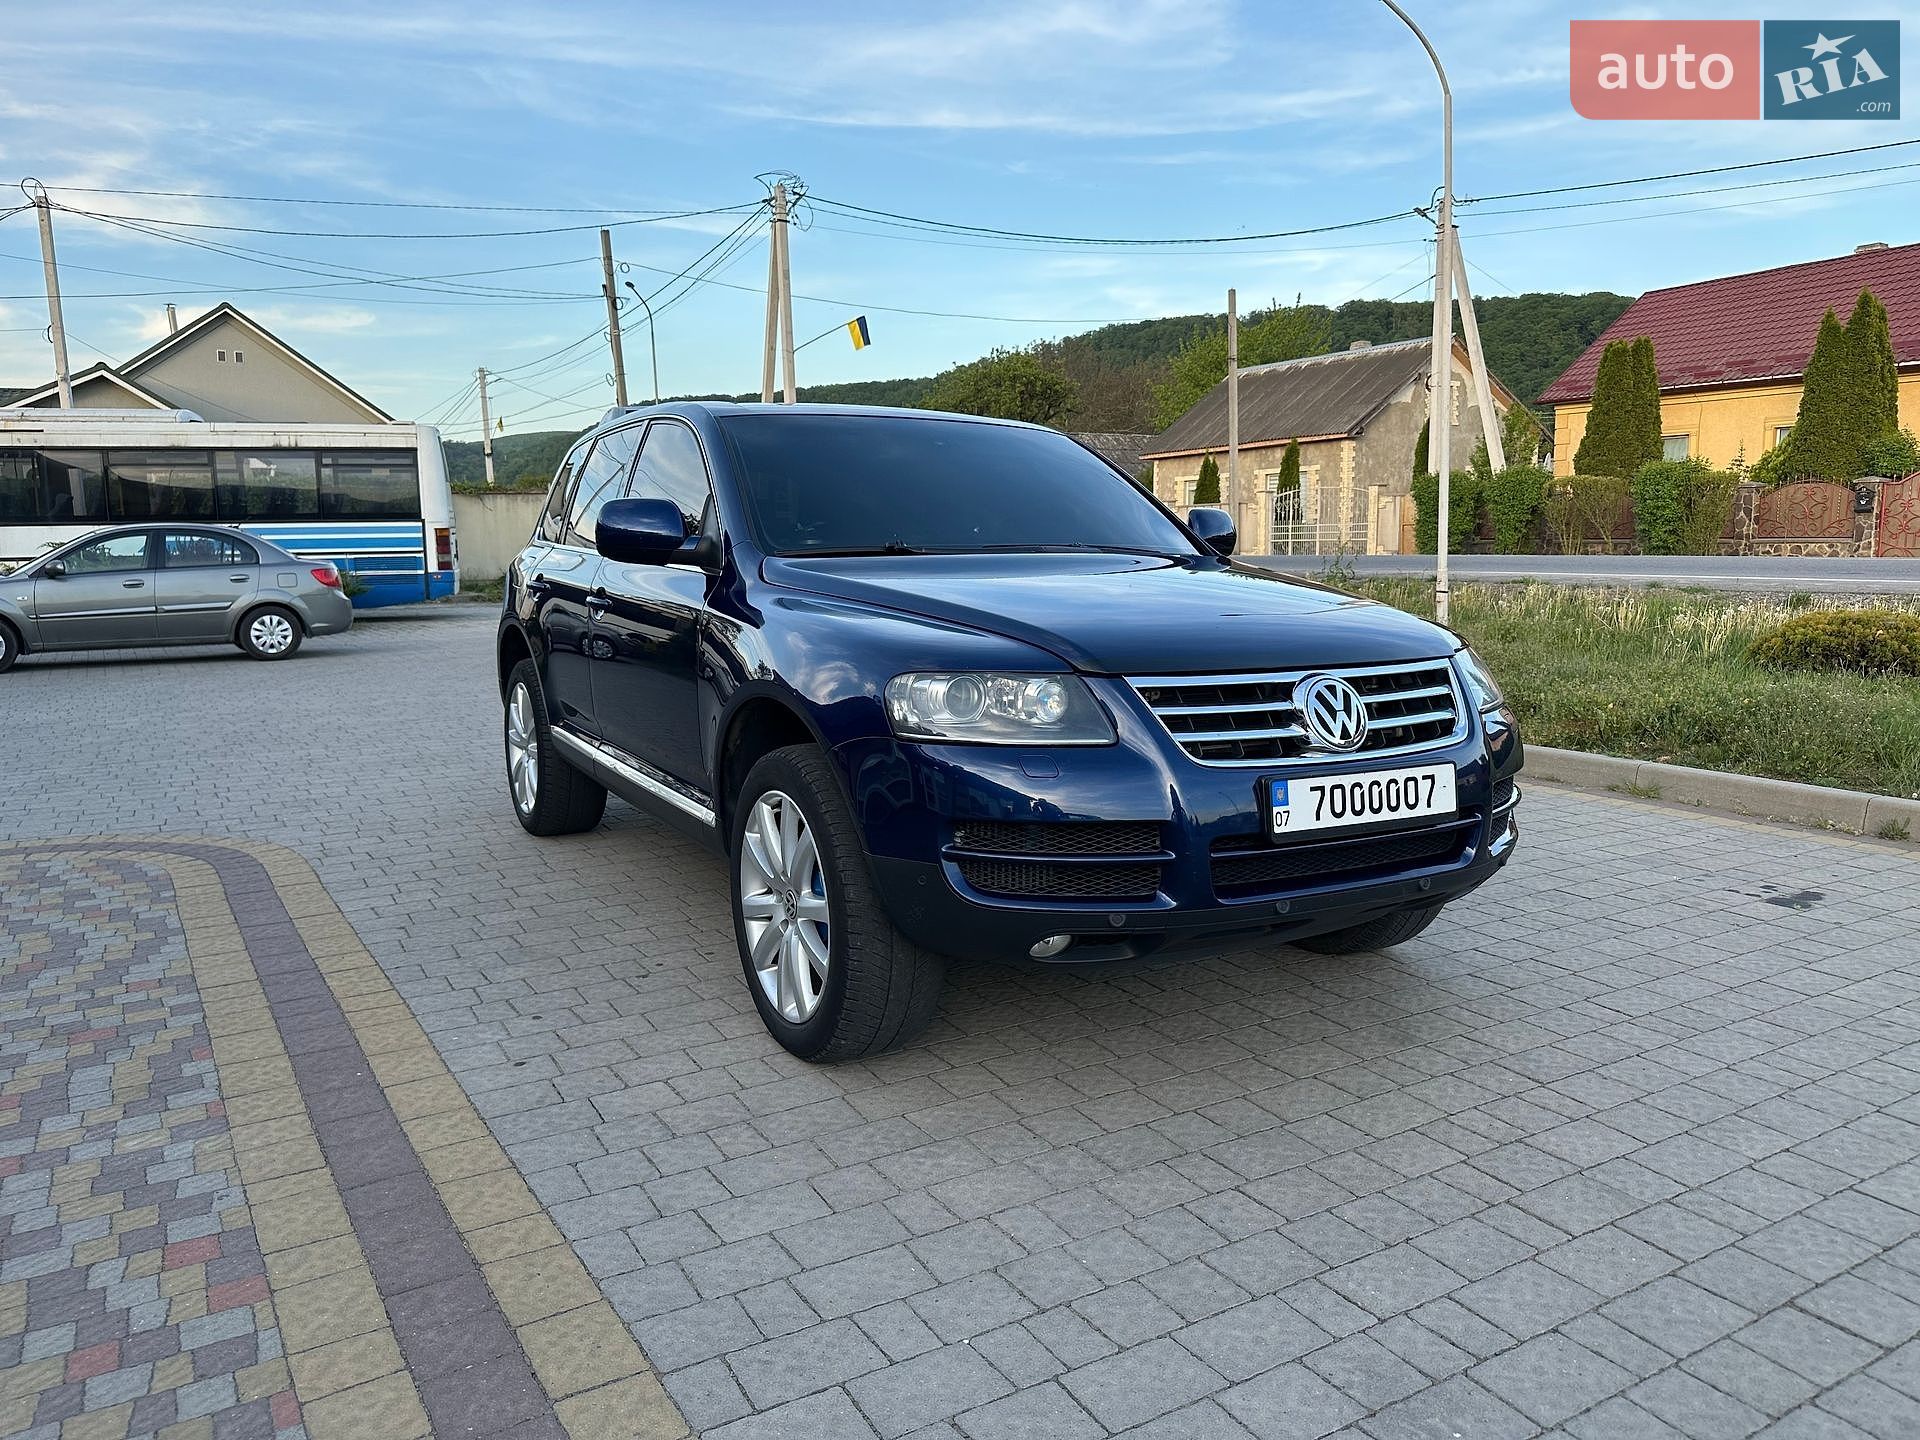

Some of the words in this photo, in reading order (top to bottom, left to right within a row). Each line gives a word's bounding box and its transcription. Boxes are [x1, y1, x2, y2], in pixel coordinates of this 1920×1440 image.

[1307, 678, 1363, 743] VW
[1274, 810, 1290, 827] 07
[1309, 773, 1436, 822] 7000007
